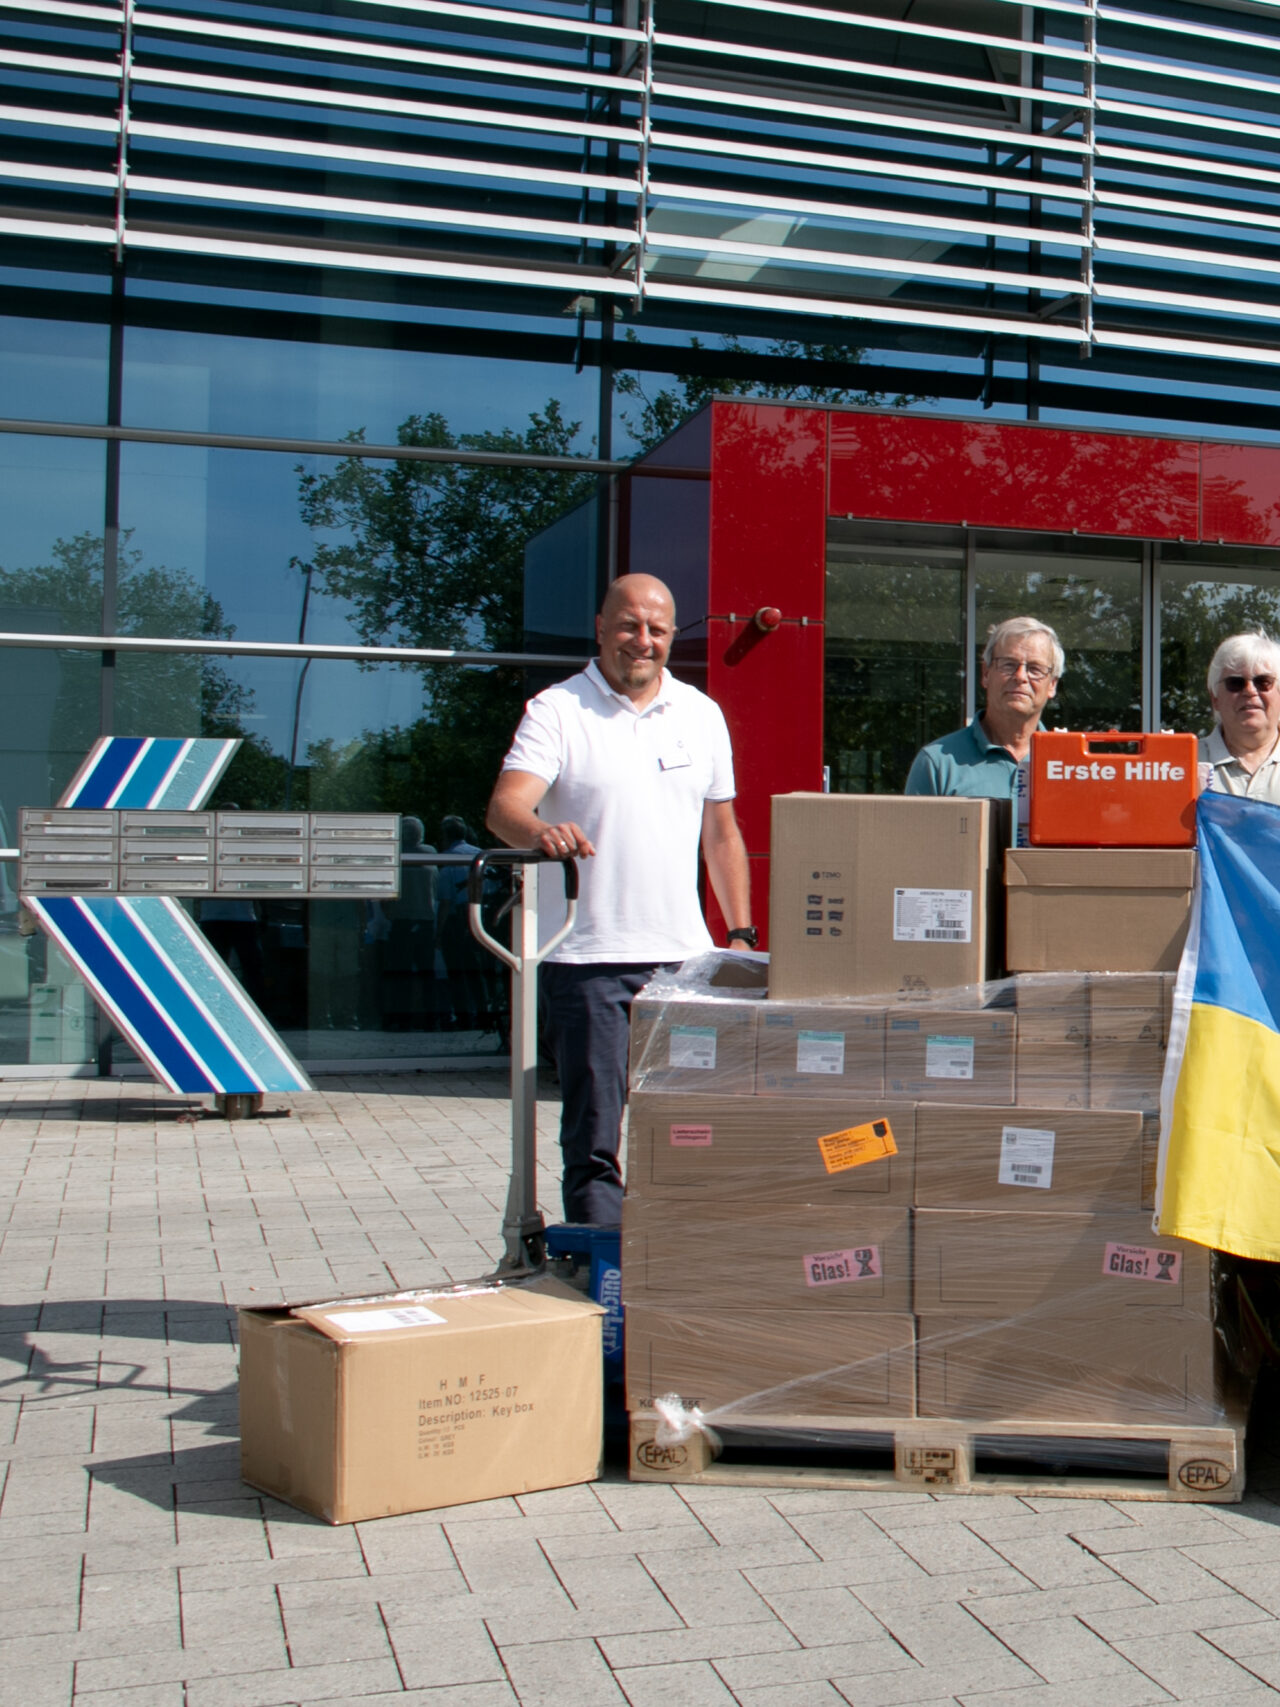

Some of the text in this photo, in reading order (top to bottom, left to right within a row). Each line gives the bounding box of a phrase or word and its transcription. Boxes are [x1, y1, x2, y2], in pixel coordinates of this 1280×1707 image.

[1047, 760, 1116, 780] Erste
[1124, 761, 1185, 781] Hilfe
[811, 1259, 851, 1282] Glas!
[1109, 1253, 1149, 1276] Glas!
[418, 1402, 534, 1426] Description: Key box
[419, 1398, 443, 1409] Item
[645, 1444, 681, 1463] EPAL
[1187, 1466, 1224, 1484] EPAL
